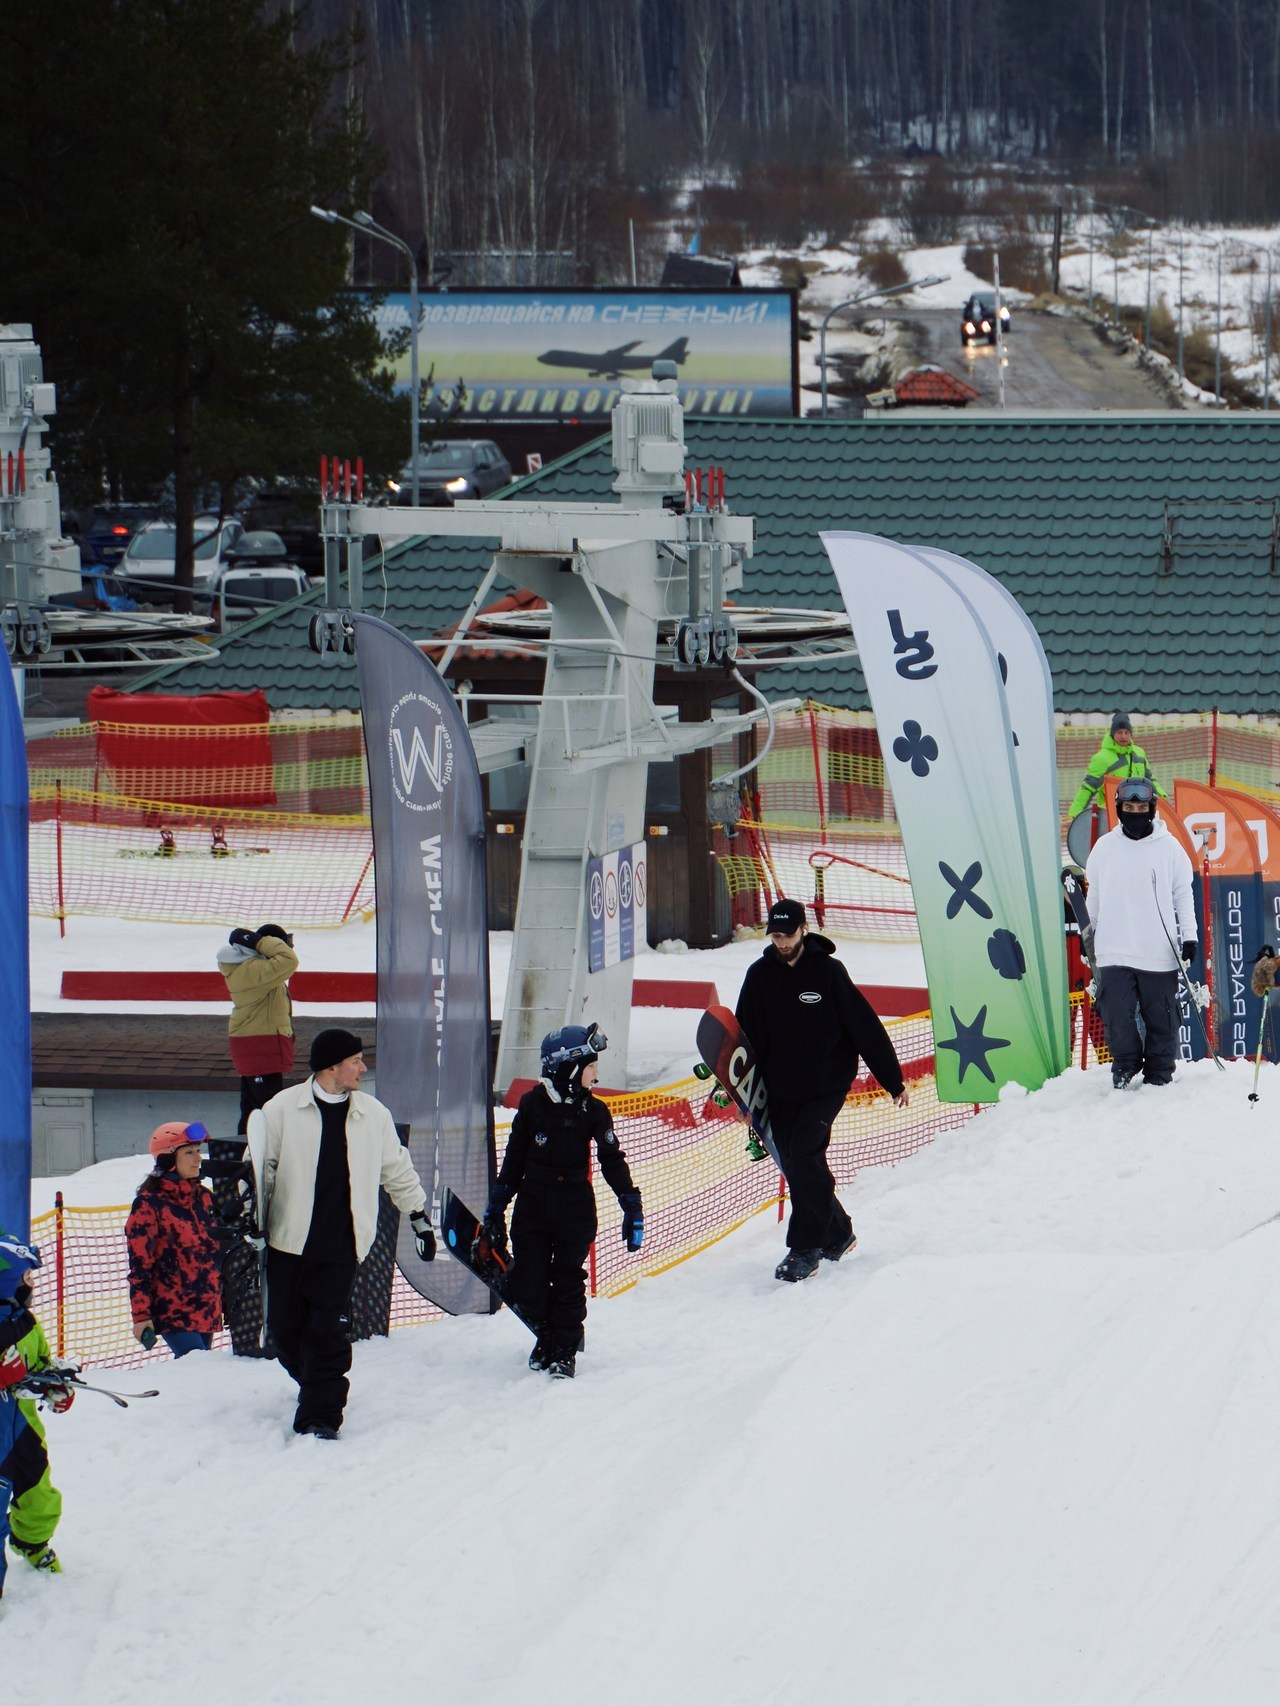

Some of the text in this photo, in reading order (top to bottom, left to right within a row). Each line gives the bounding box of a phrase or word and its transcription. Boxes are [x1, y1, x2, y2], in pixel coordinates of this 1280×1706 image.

[567, 305, 597, 324] на
[420, 389, 753, 413] СЧАСТЛИВОГ УТИ!
[728, 1046, 772, 1138] CAPI
